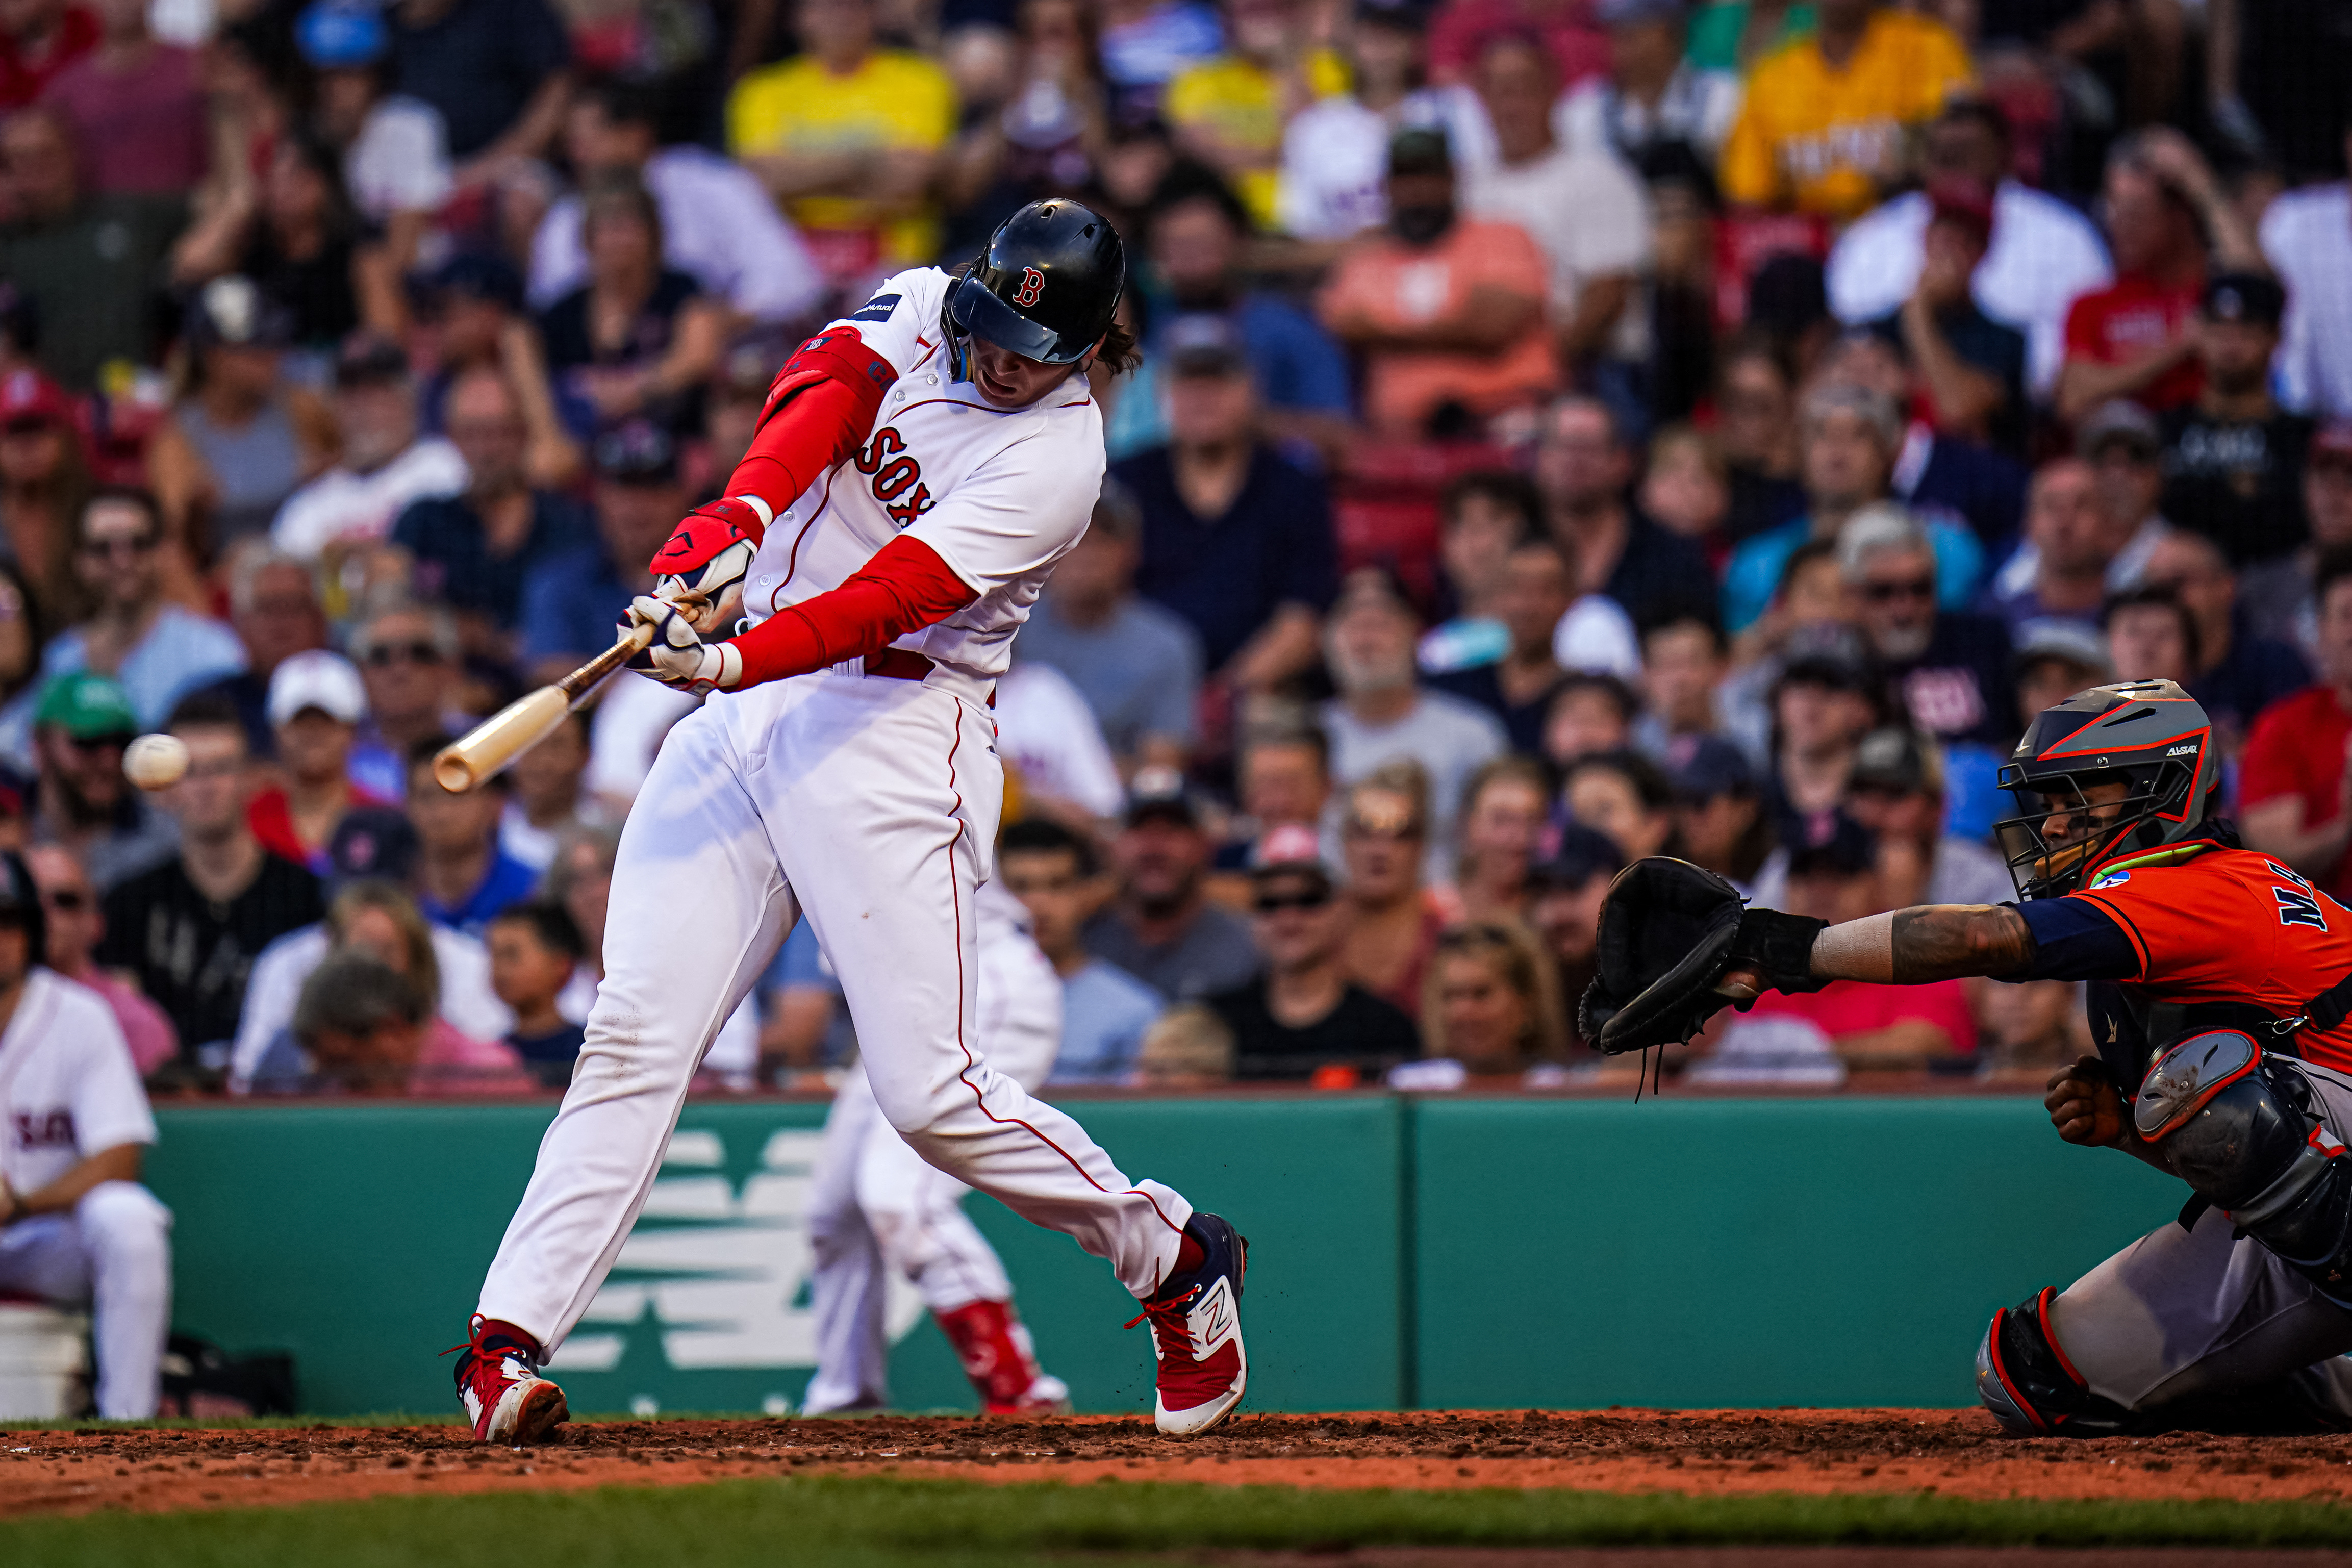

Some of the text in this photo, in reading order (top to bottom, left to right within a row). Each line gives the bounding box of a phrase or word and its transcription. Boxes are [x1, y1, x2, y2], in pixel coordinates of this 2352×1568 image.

[1013, 266, 1045, 307] B
[853, 304, 894, 315] Mutual
[853, 426, 937, 529] SOX
